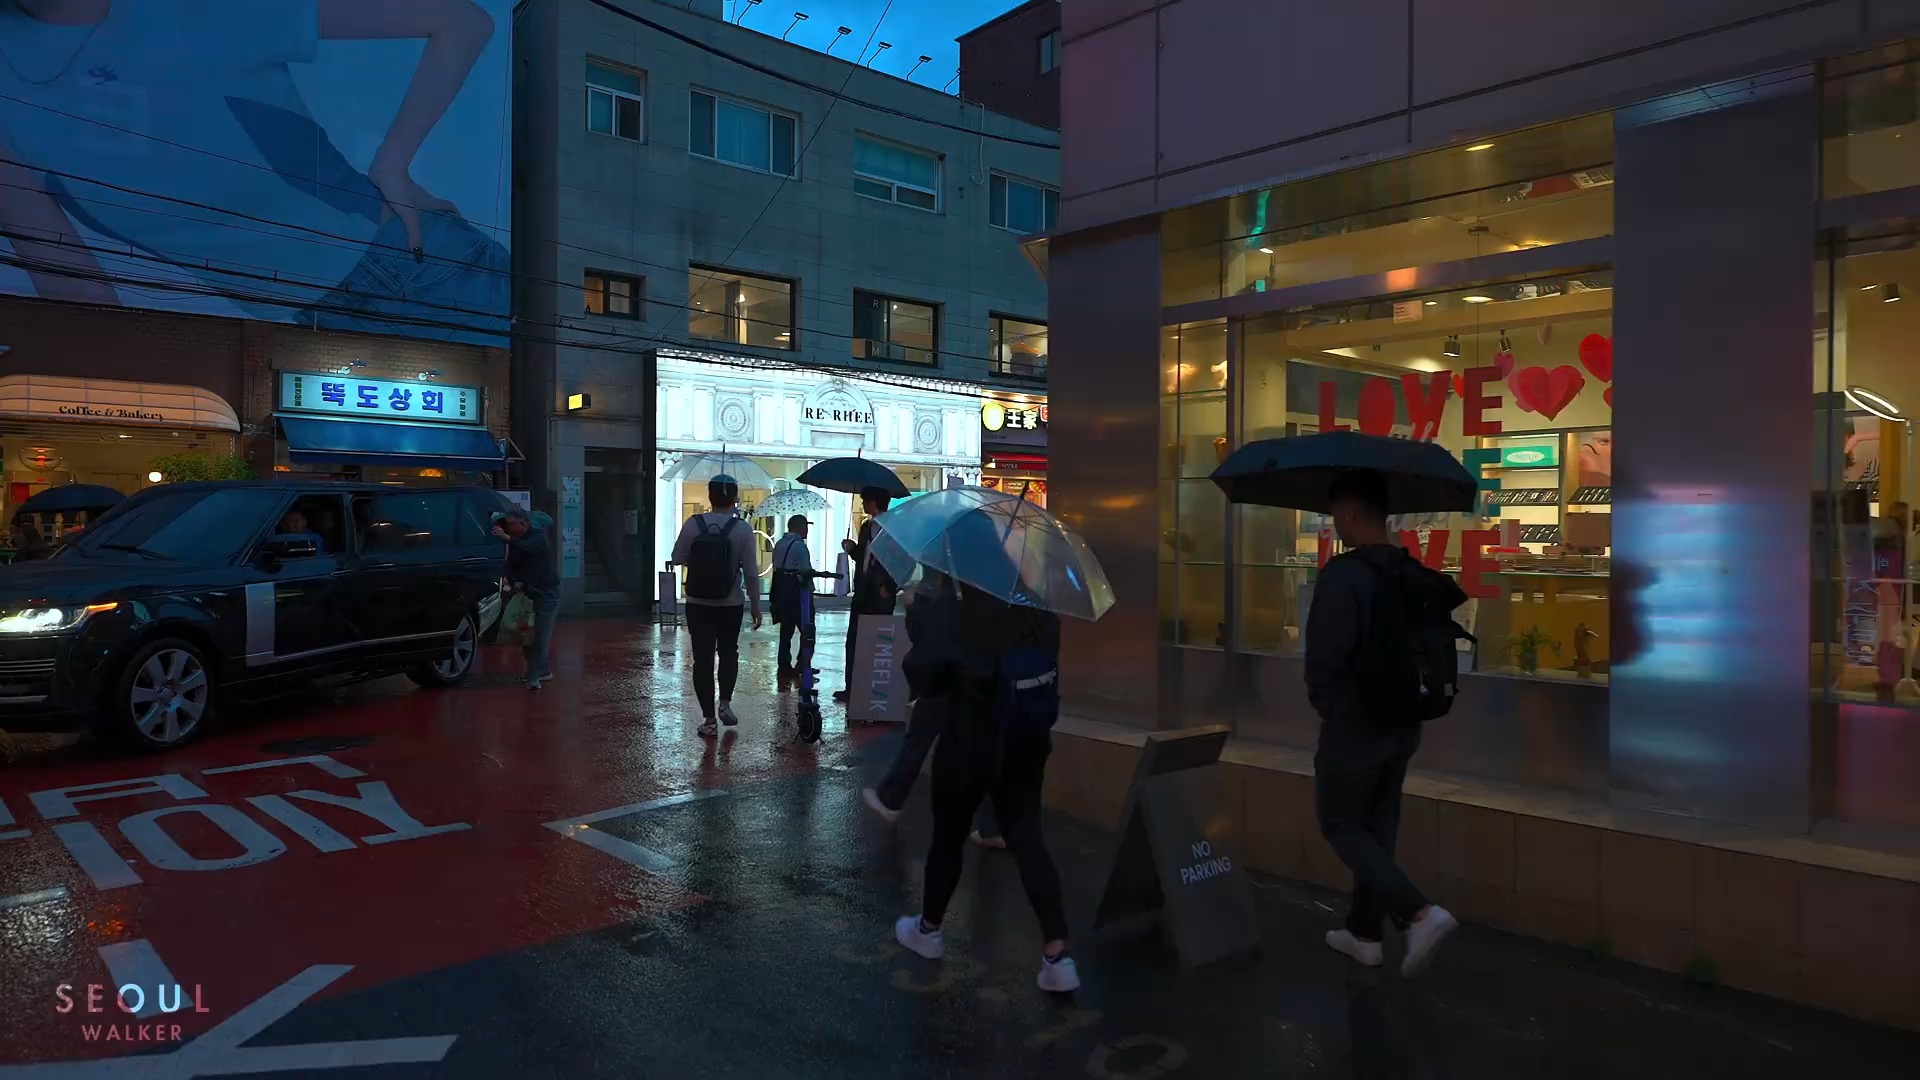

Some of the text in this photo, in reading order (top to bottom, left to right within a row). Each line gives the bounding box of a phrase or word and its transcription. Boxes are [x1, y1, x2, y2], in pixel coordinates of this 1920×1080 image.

[321, 382, 444, 413] 뚝도상회
[1319, 366, 1503, 436] LOVE
[59, 405, 164, 421] Coffee & Bakery
[805, 407, 825, 420] RE
[1191, 840, 1211, 860] NO
[1180, 856, 1232, 885] PARKING
